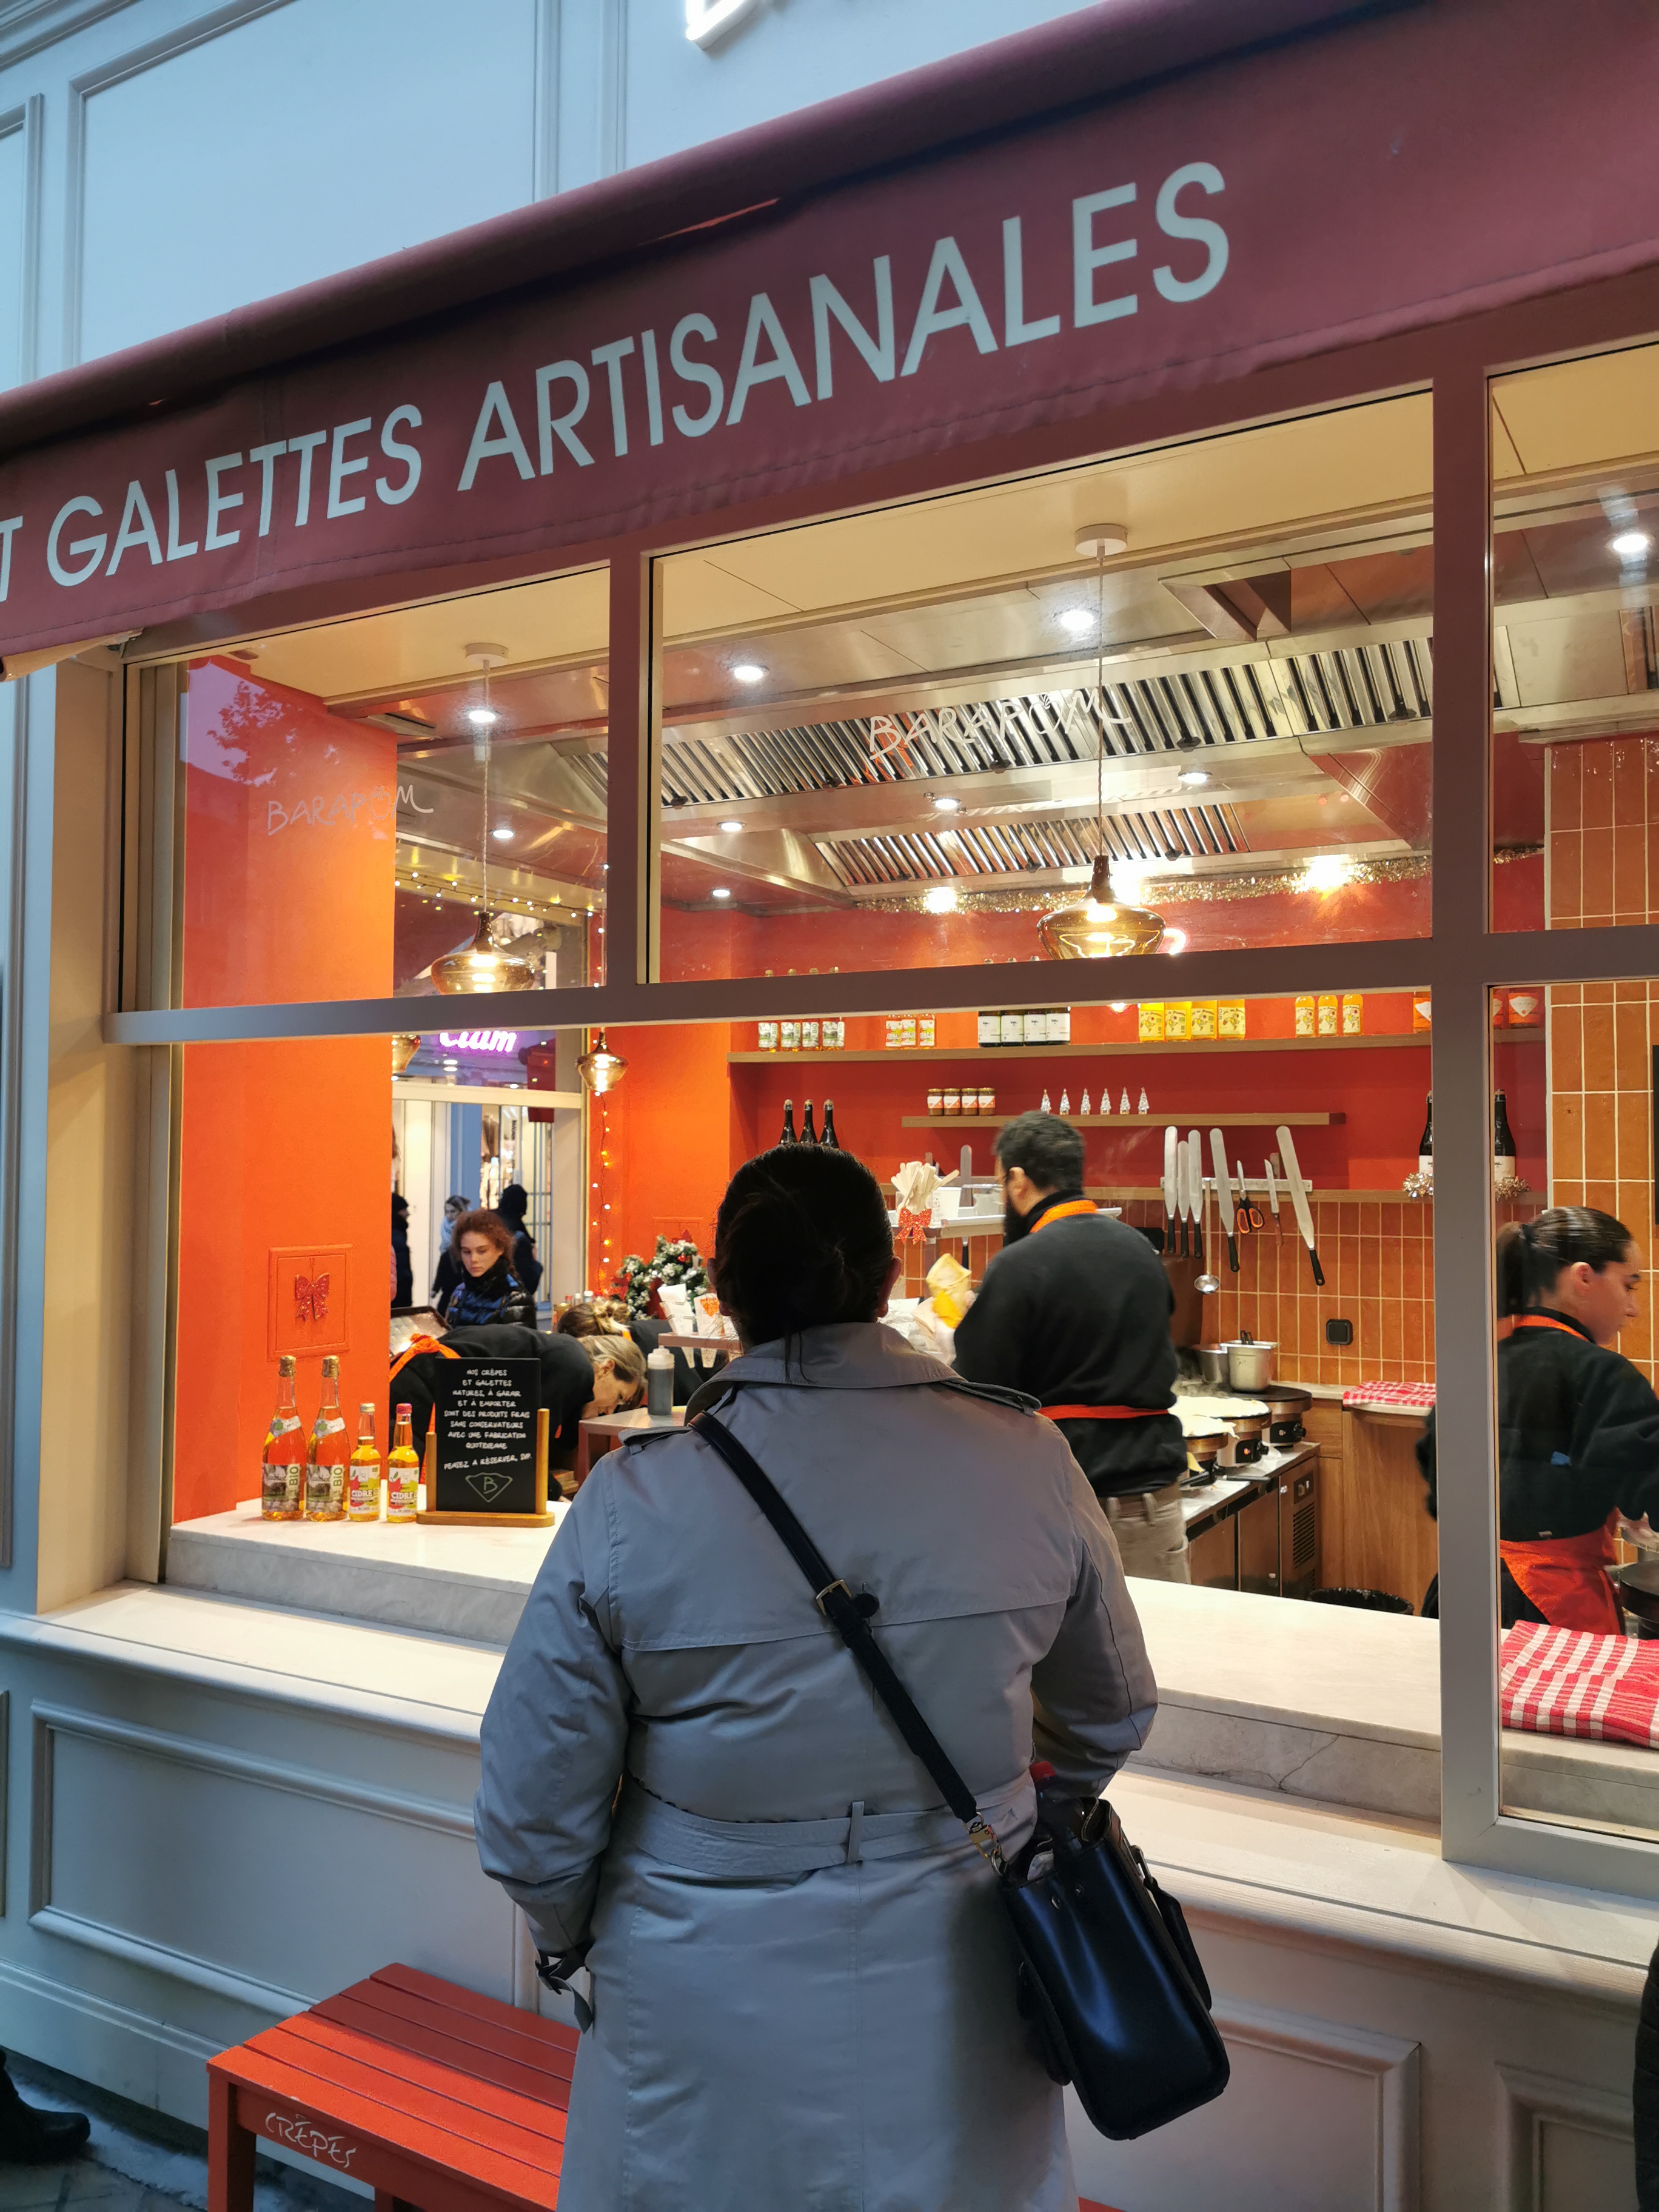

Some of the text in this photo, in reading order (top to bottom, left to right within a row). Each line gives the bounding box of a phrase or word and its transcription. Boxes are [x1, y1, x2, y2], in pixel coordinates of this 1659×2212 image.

[47, 404, 422, 588] GALETTES
[458, 161, 1229, 491] ARTISANALES
[289, 1466, 299, 1486] BIO
[333, 1467, 343, 1486] BIO
[483, 1476, 498, 1494] B
[352, 1489, 374, 1498] CIDRE
